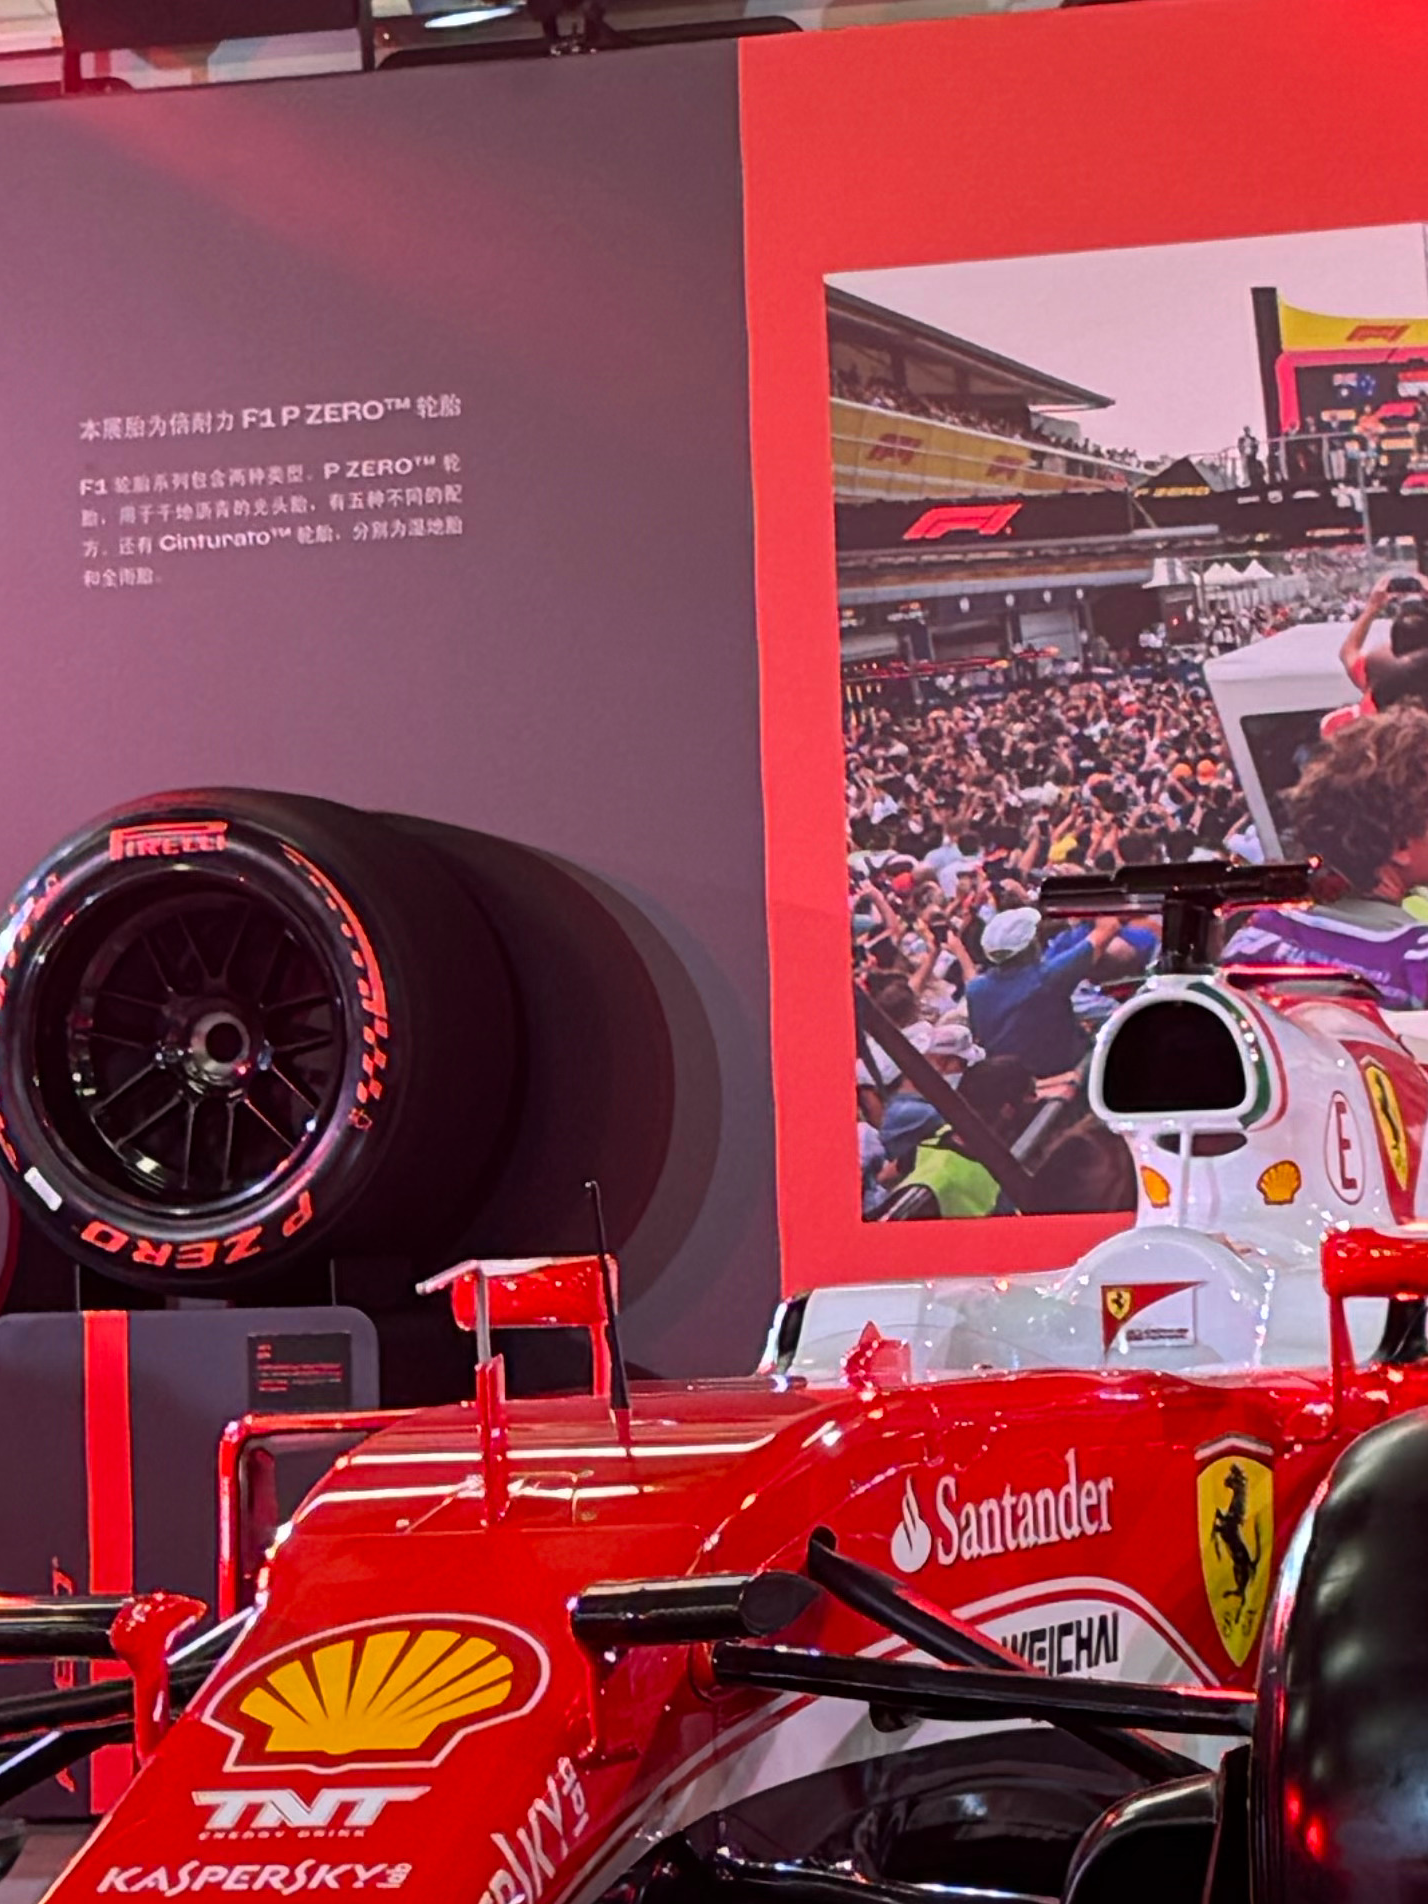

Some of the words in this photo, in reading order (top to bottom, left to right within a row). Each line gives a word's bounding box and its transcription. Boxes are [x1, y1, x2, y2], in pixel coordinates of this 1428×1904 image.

[79, 409, 235, 441] 本展胎为倍耐力
[242, 407, 276, 429] F1
[282, 405, 301, 427] P
[416, 393, 461, 419] 轮胎
[80, 478, 108, 496] F1
[324, 461, 339, 480] P
[443, 453, 461, 474] 轮
[159, 527, 292, 552] Cinturato™
[109, 821, 228, 862] PIRELLI
[281, 1190, 314, 1238] P
[80, 1219, 265, 1270] ZERO
[936, 1448, 1115, 1566] Santander
[1002, 1611, 1120, 1677] WEICHAI
[191, 1786, 432, 1830] TNT
[96, 1859, 389, 1897] KASPERSKY
